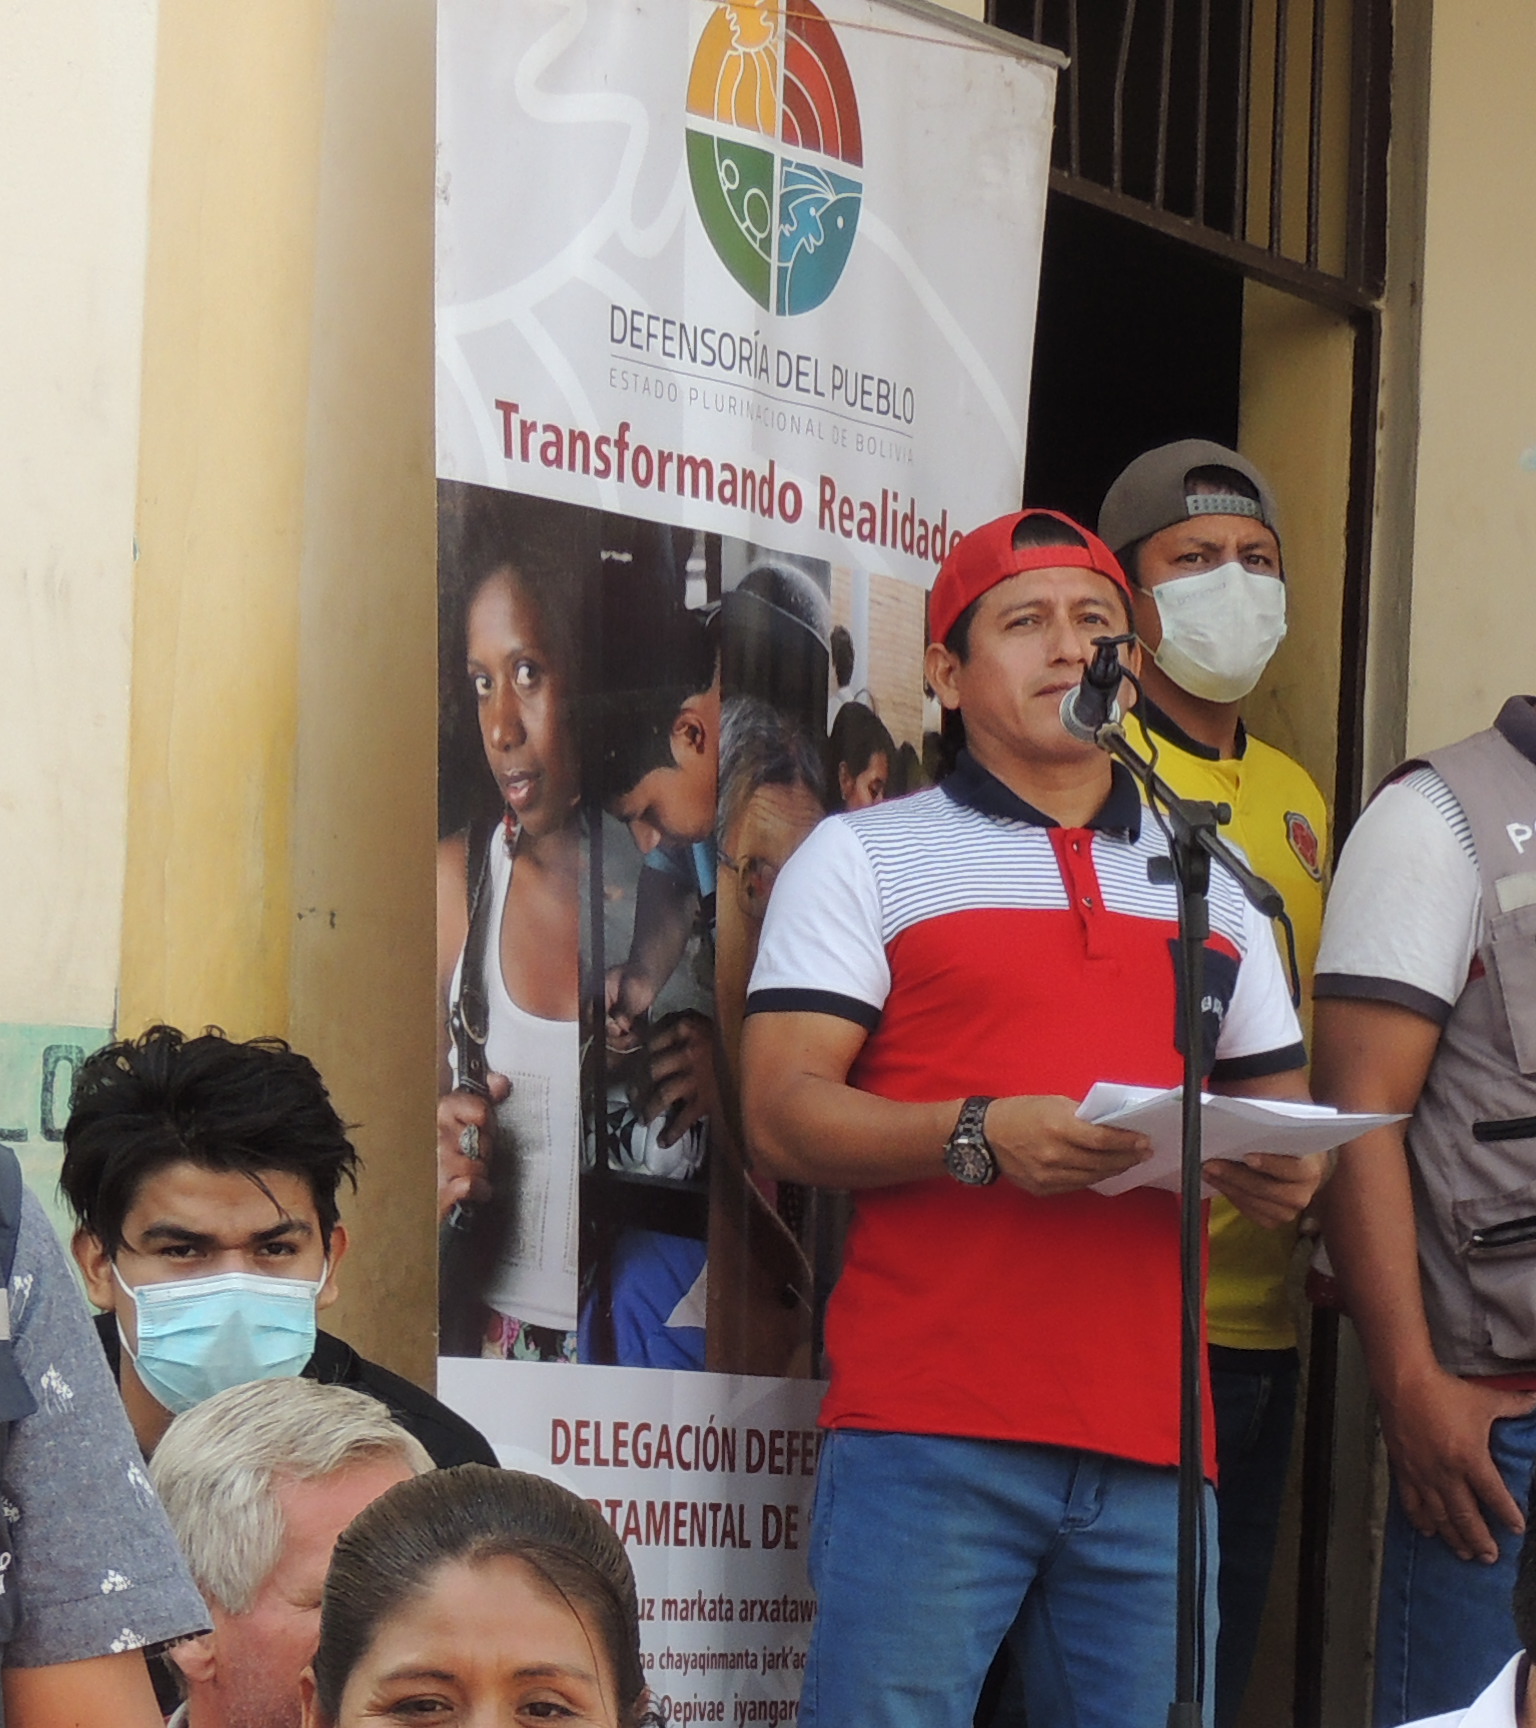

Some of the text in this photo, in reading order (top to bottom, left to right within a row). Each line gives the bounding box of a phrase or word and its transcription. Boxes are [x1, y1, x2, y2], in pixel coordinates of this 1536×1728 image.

[610, 304, 915, 425] DEFENSORÍA DEL PUEBLO
[609, 367, 914, 464] ESTADO PLURINACIONAL DE BOLIVIA
[495, 399, 803, 524] Transformando
[551, 1414, 737, 1473] DELEGACIÓN
[761, 1504, 799, 1550] DE
[661, 1589, 734, 1622] markata
[659, 1646, 758, 1676] chayaqinmanta
